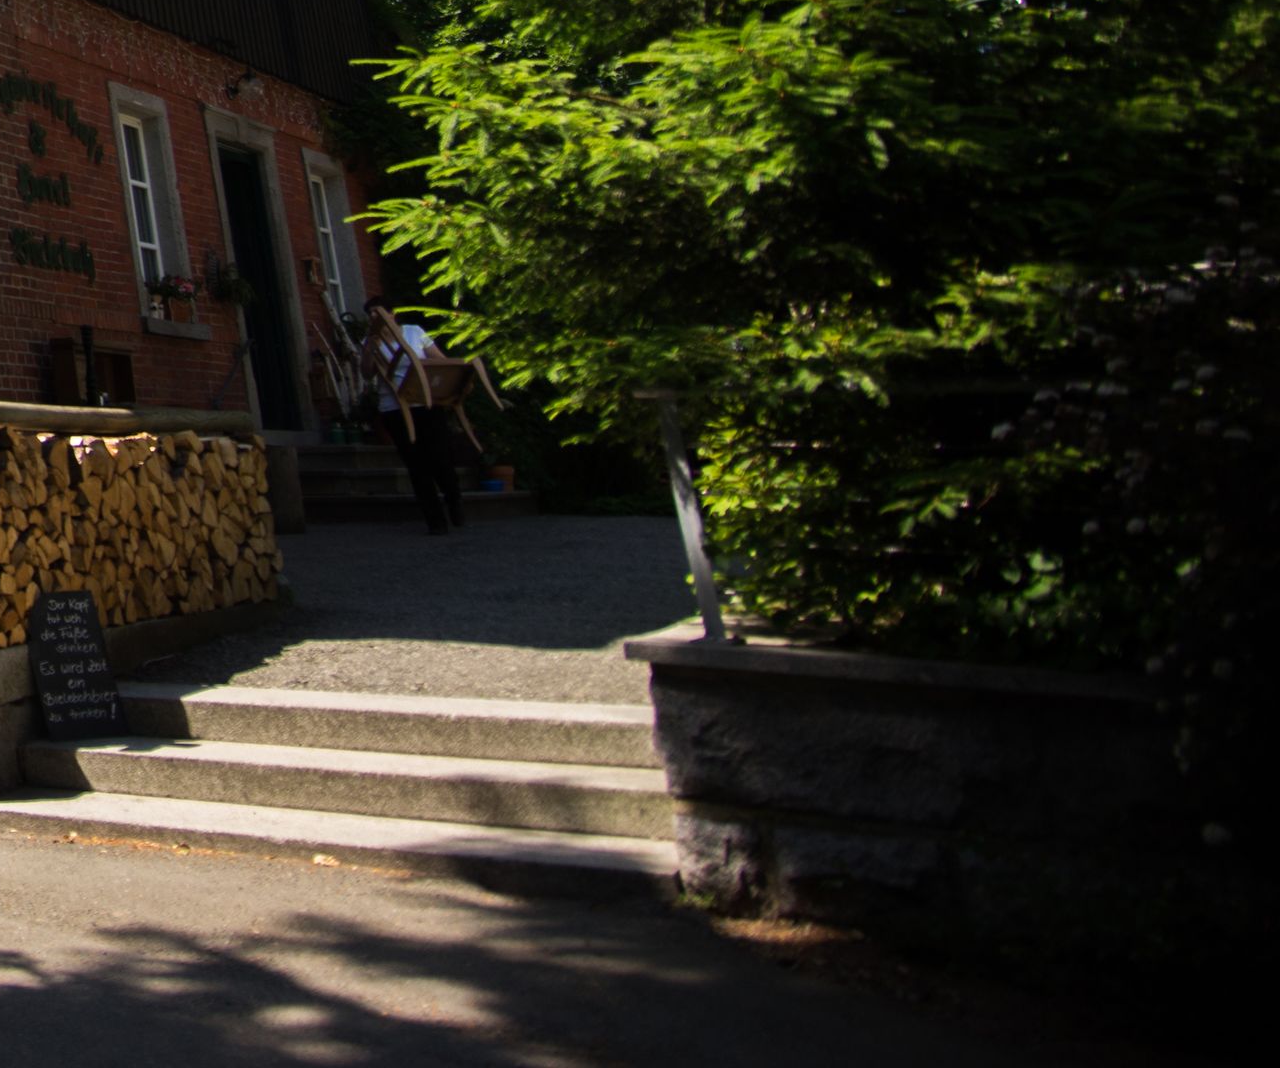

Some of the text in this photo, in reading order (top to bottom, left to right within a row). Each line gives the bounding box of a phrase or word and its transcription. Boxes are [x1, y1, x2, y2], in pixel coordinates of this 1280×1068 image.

[47, 598, 89, 613] Der Kopf
[40, 629, 57, 641] die
[40, 661, 55, 675] Es
[60, 661, 84, 674] wird
[67, 679, 86, 689] ein
